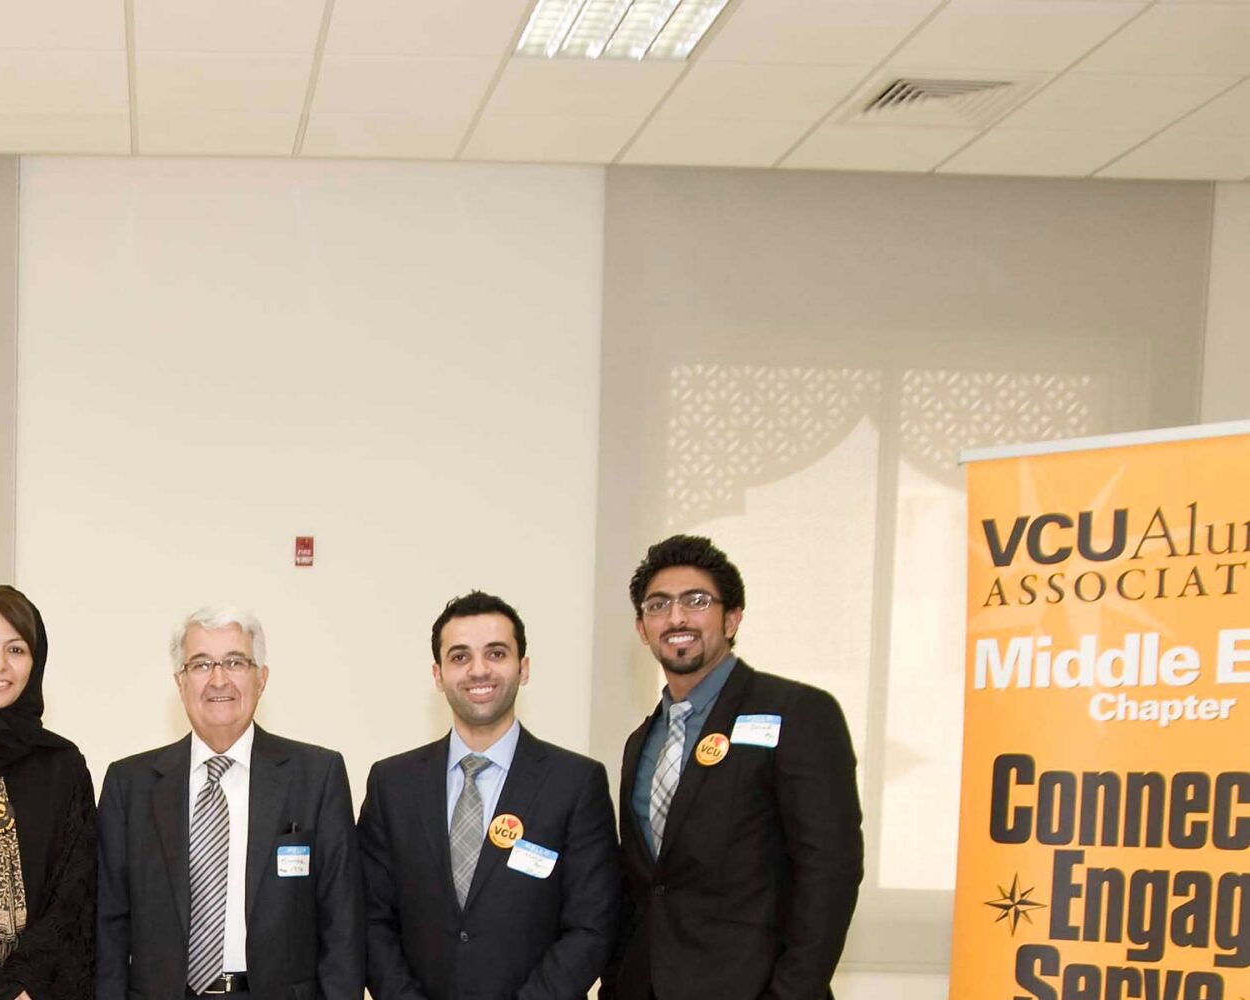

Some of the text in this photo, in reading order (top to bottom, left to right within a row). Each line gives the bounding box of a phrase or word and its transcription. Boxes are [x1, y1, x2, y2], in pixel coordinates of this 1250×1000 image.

[983, 562, 1247, 608] ASSOCIAT
[974, 632, 1201, 690] Middle
[1089, 693, 1237, 728] Chapter
[701, 744, 722, 757] VCU
[989, 753, 1250, 851] Connec
[494, 826, 518, 840] VCU
[1049, 849, 1250, 969] Engag
